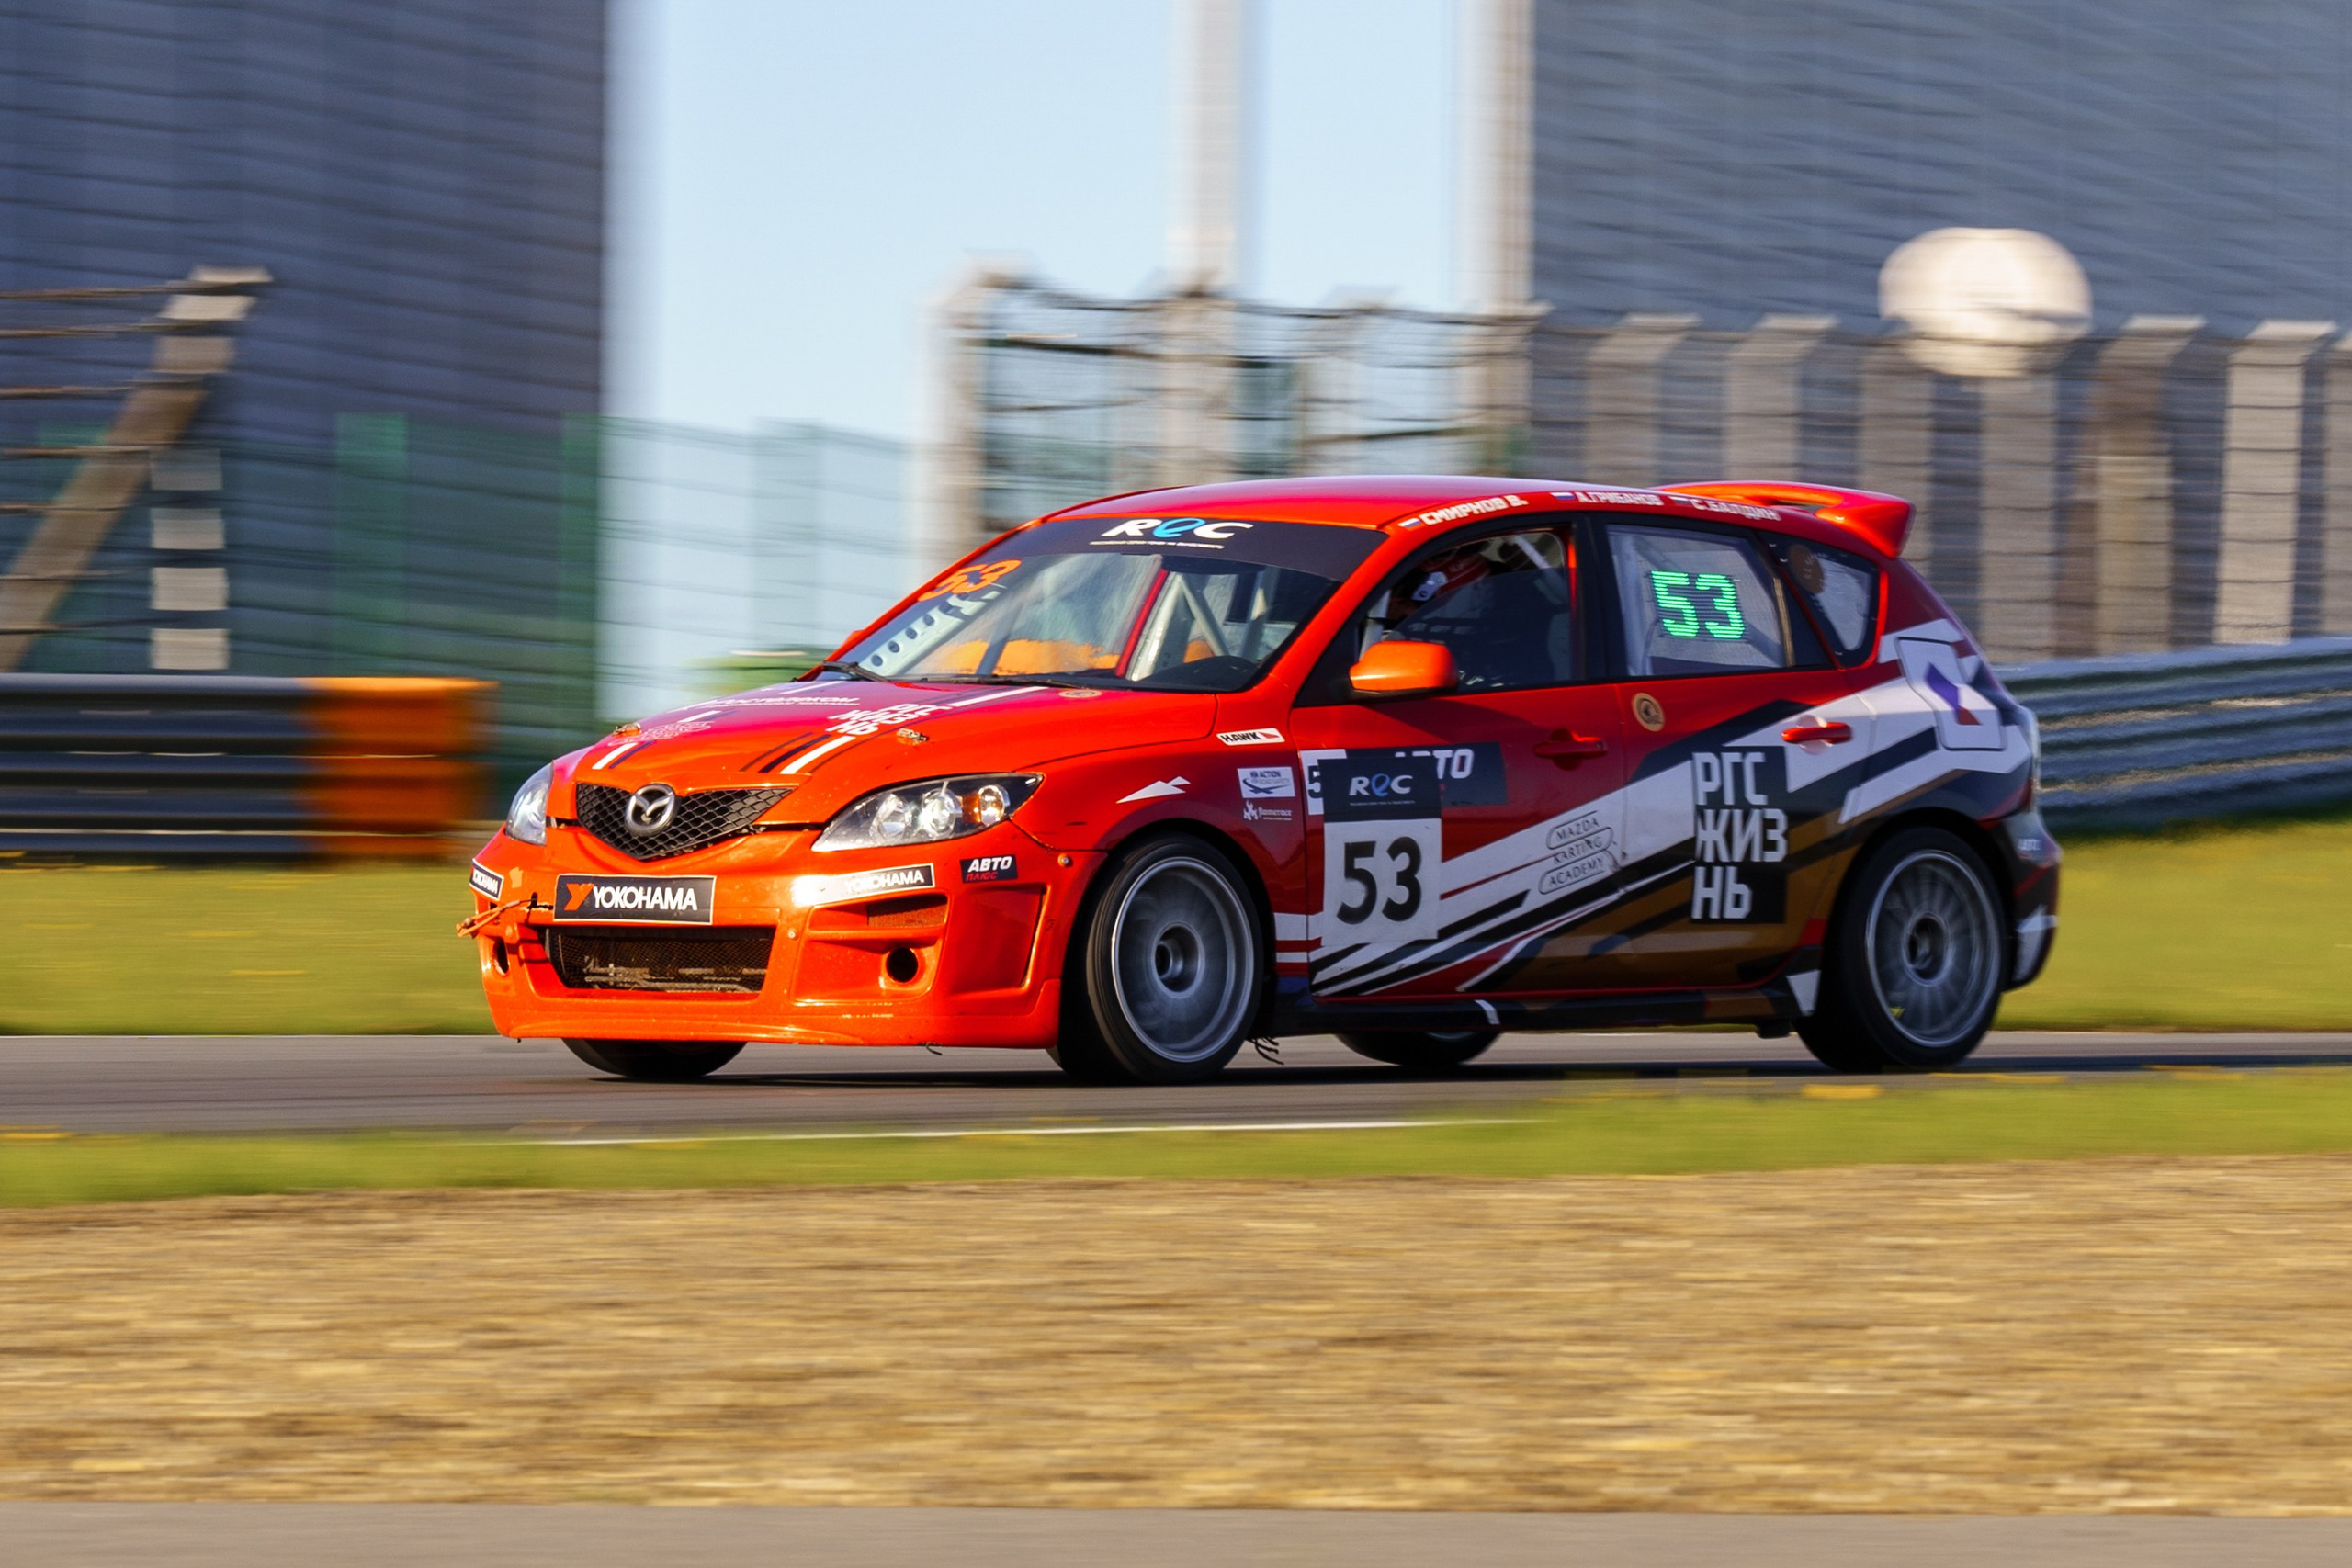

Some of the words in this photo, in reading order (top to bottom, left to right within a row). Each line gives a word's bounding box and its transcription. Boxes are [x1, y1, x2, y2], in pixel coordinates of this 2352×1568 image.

[1419, 497, 1509, 525] СМИРНОВ
[917, 559, 1022, 602] 53
[1651, 570, 1745, 639] 53
[1220, 731, 1261, 742] HAWK
[1692, 751, 1768, 806] РГС
[1556, 818, 1599, 840] MAZDA
[1695, 808, 1788, 862] ЖИЗ
[967, 856, 1012, 873] АВТО
[1549, 857, 1603, 886] ACADEMY
[844, 870, 925, 893] YOKOHAMA
[1336, 836, 1422, 925] 53
[1691, 865, 1752, 919] НЬ
[593, 886, 698, 911] YOKOHAMA
